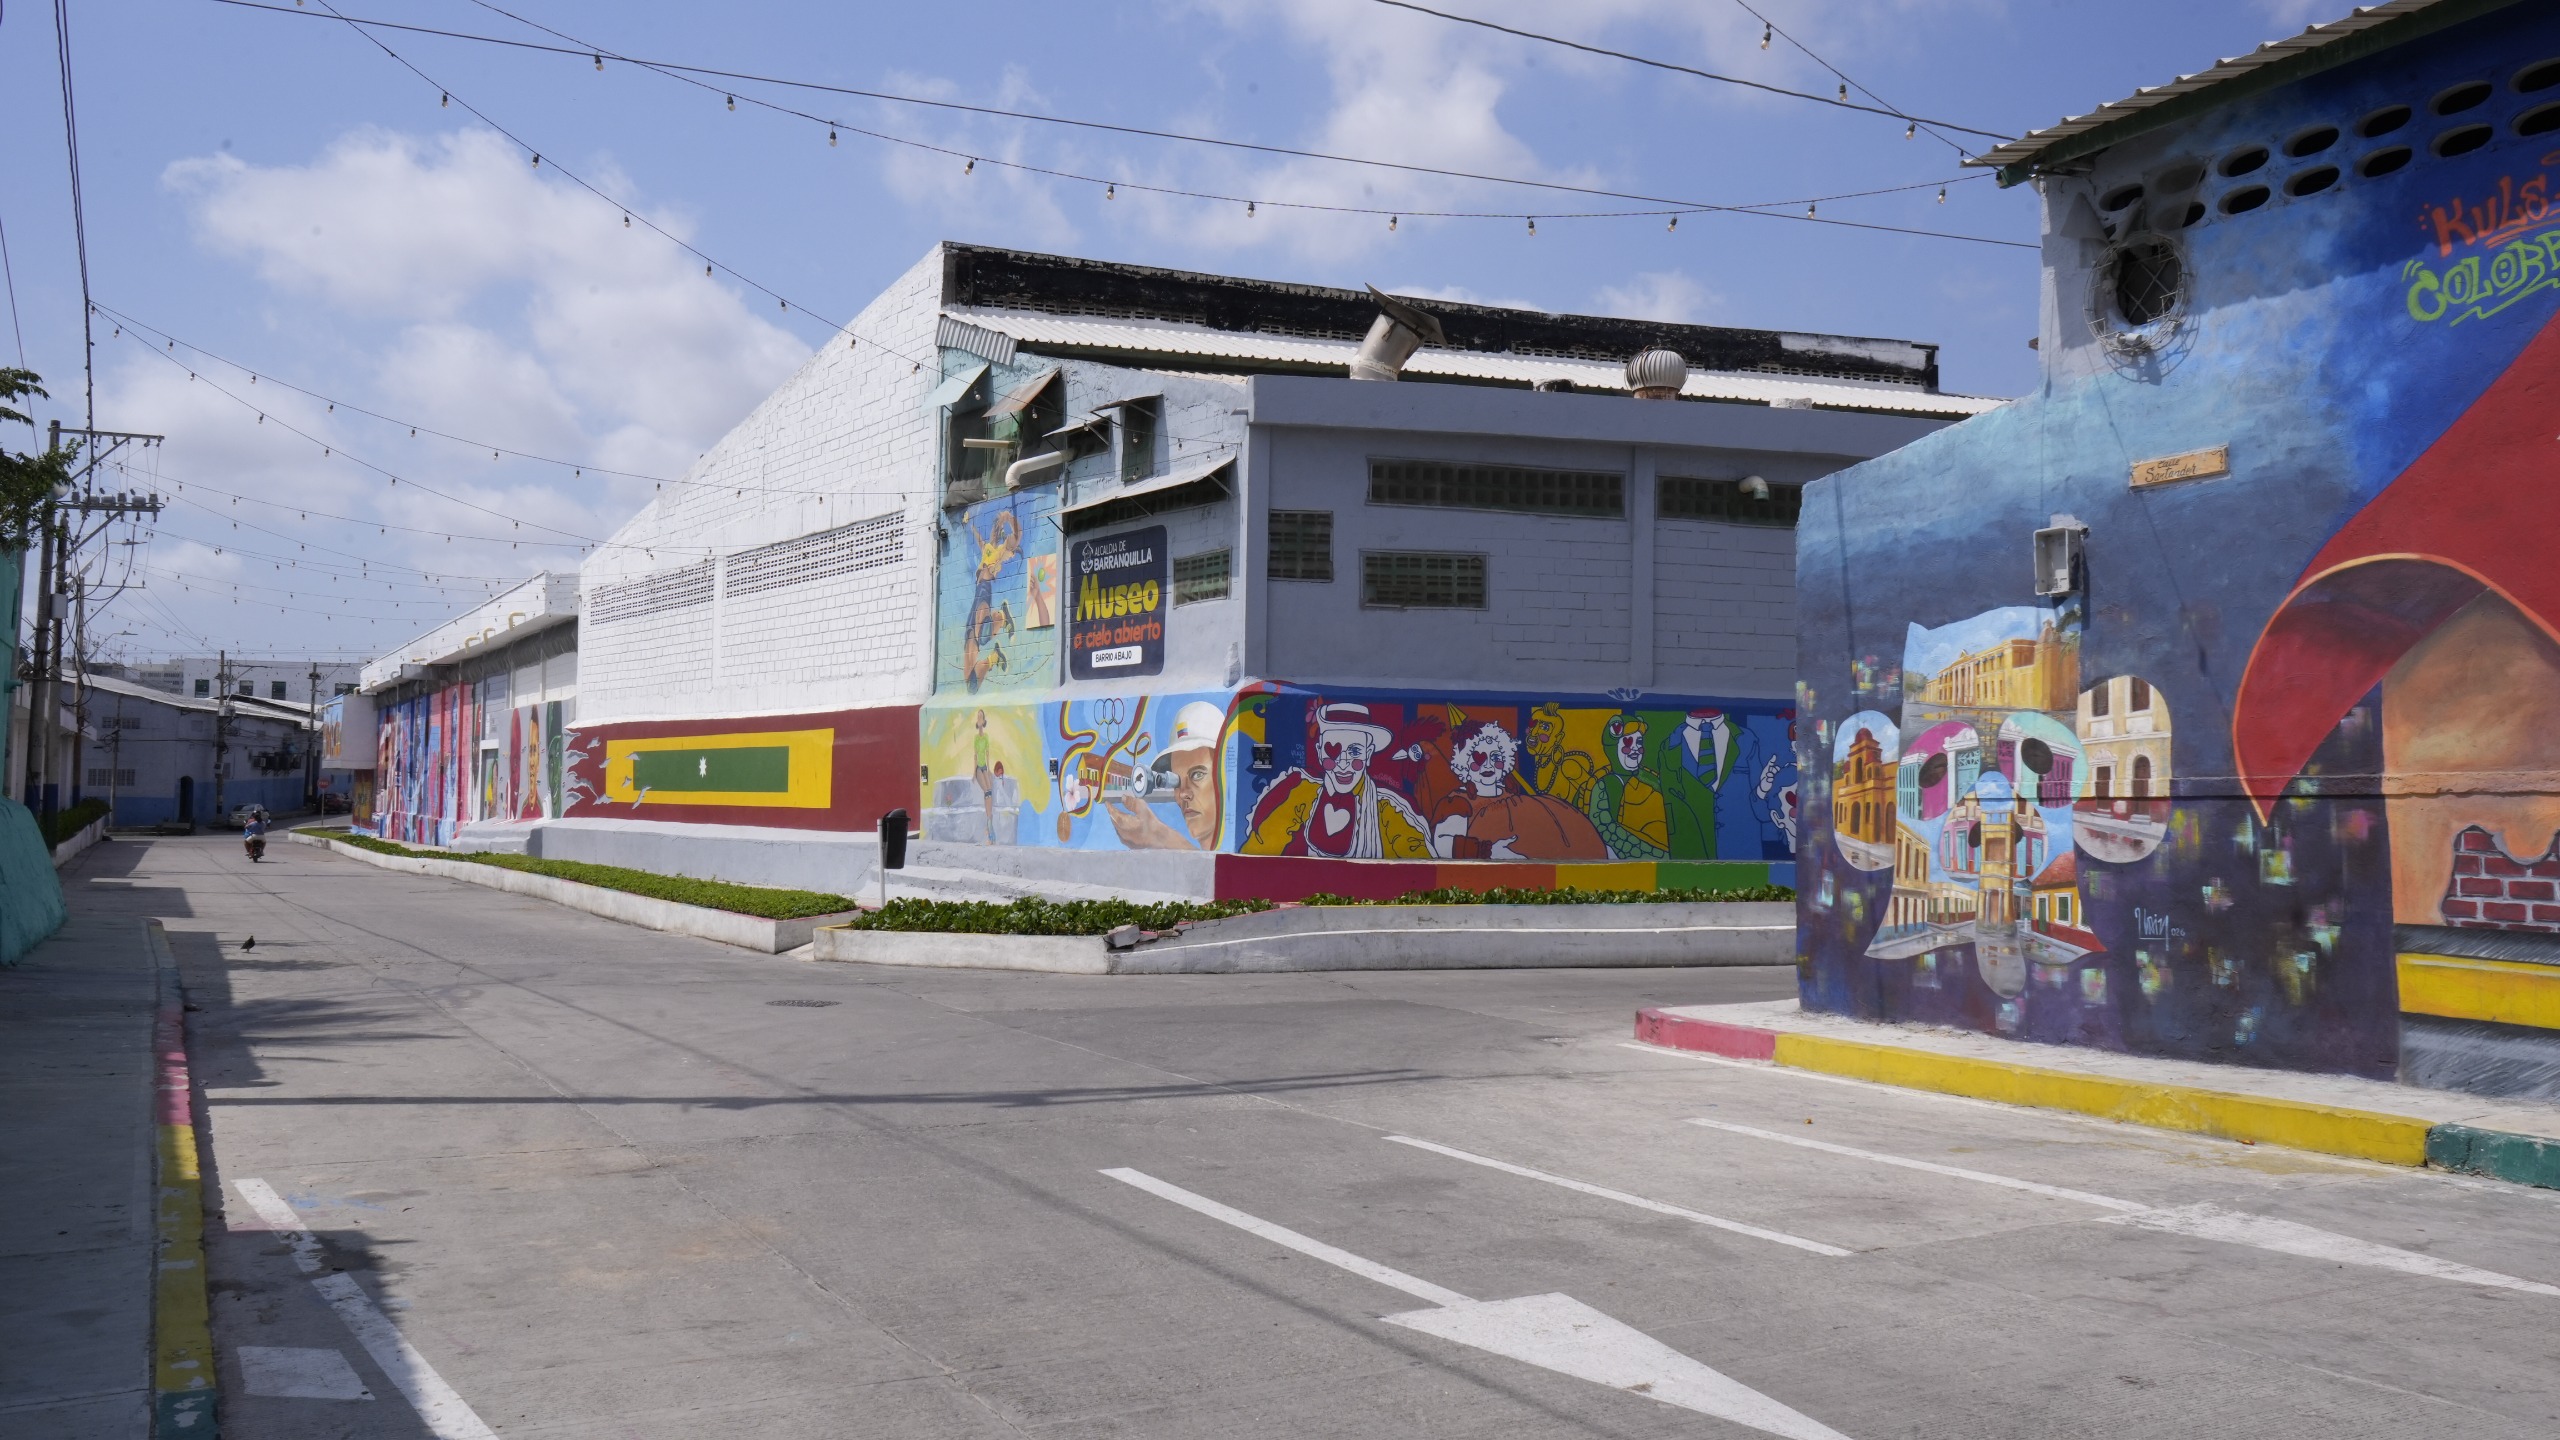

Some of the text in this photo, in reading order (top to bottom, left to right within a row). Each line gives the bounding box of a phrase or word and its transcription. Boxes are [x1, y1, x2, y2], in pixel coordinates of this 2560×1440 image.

[1119, 540, 1126, 551] DE
[1093, 547, 1153, 572] BARRANQUILLA
[1076, 573, 1160, 622] Museo
[1073, 616, 1161, 649] a cielo abierto
[1095, 650, 1132, 663] BARRIO ABAJO
